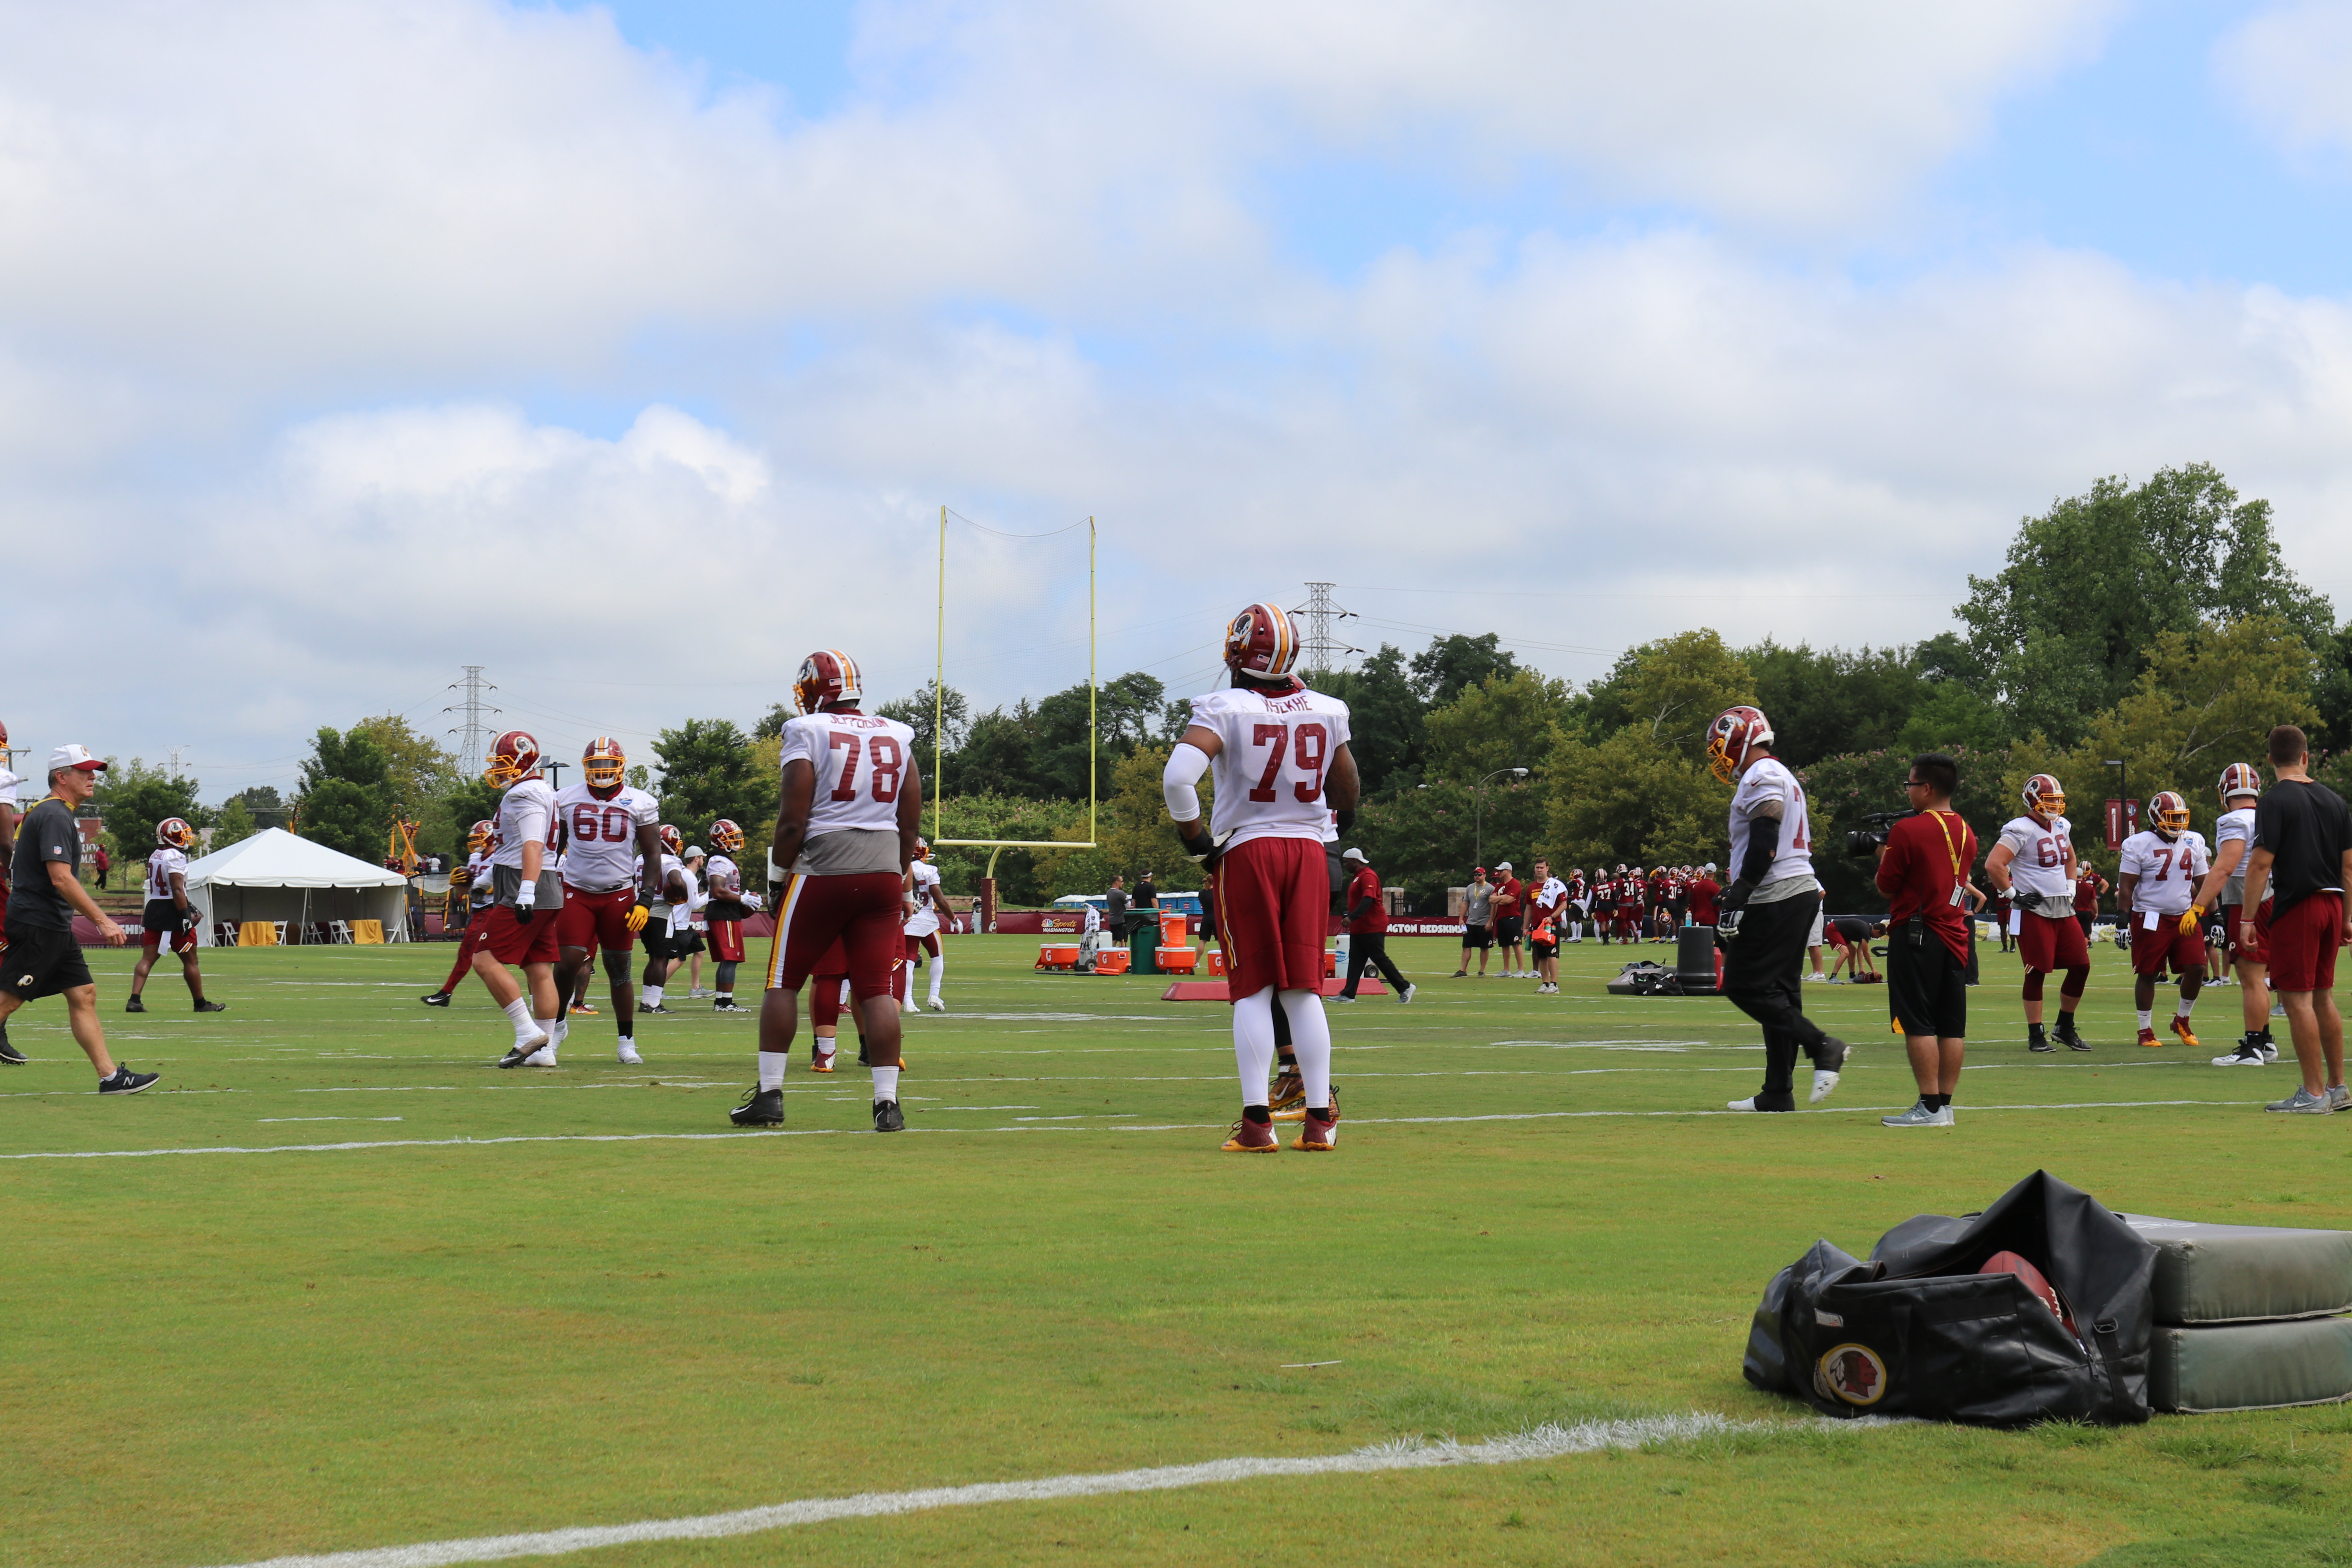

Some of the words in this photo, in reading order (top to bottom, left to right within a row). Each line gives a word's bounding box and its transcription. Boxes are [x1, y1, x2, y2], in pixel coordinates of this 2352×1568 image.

[829, 731, 902, 803] 78
[1249, 723, 1327, 803] 79
[573, 803, 629, 843] 60
[2037, 833, 2067, 867] 66
[2153, 848, 2193, 881] 74
[1597, 888, 1611, 900] 37
[1623, 881, 1634, 897] 34
[1668, 885, 1677, 900] 31
[1052, 918, 1078, 928] Sports
[1386, 924, 1417, 933] NGTON
[1420, 924, 1463, 933] REDSKINS
[1045, 949, 1052, 962] G
[1102, 953, 1107, 964] G
[1159, 953, 1164, 965] G
[1215, 956, 1221, 967] G
[123, 1076, 135, 1086] N
